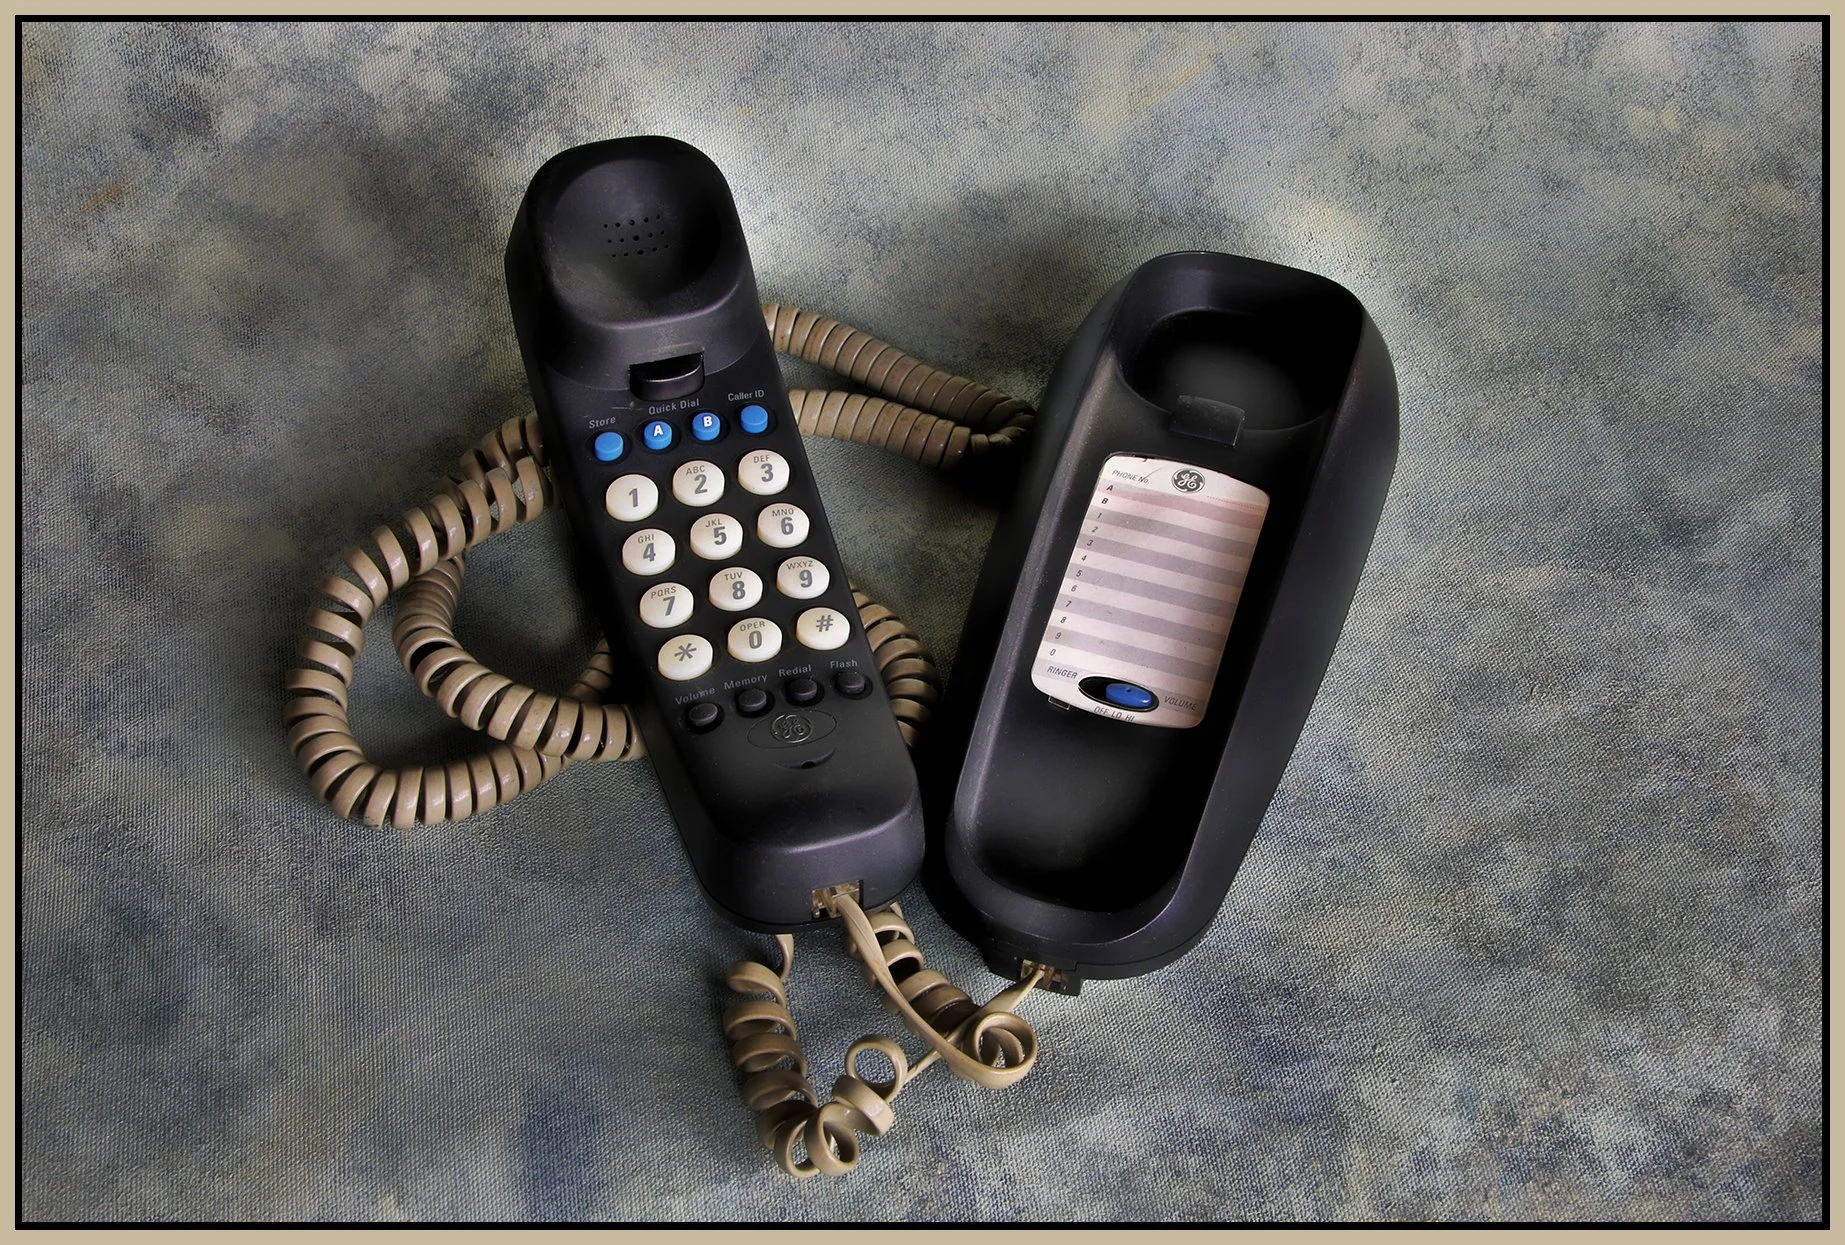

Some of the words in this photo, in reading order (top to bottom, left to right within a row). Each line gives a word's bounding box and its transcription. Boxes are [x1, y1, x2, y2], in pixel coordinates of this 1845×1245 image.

[728, 391, 753, 402] Caller
[754, 389, 765, 399] ID
[648, 402, 677, 416] Quick
[680, 398, 700, 411] Dial
[589, 415, 616, 429] Store
[703, 416, 713, 427] B
[653, 425, 664, 437] A
[753, 454, 770, 464] DEF
[686, 465, 706, 475] ABC
[761, 463, 774, 482] 3
[1112, 470, 1137, 483] PHONE
[694, 474, 708, 495] 2
[1106, 484, 1114, 492] A
[628, 487, 639, 508] 1
[771, 508, 794, 517] MNO
[705, 518, 723, 528] JKL
[780, 516, 794, 535] 6
[637, 534, 655, 544] GHI
[713, 526, 727, 546] 5
[642, 543, 656, 562] 4
[786, 560, 813, 571] WXYZ
[724, 571, 743, 581] TUV
[799, 569, 813, 588] 9
[650, 585, 677, 599] PQRS
[732, 580, 746, 600] 8
[663, 596, 676, 616] 7
[1065, 600, 1072, 608] 7
[739, 620, 766, 631] OPER
[748, 630, 763, 649] 0
[1055, 632, 1062, 640] 9
[778, 664, 812, 678] Redial
[830, 659, 858, 670] Flash
[1047, 666, 1078, 679] RINGER
[723, 673, 768, 690] Memory
[675, 687, 715, 705] Volume
[1164, 696, 1198, 711] VOLUME
[1094, 706, 1109, 716] OFF
[1111, 711, 1122, 719] LO
[1125, 714, 1135, 722] HI
